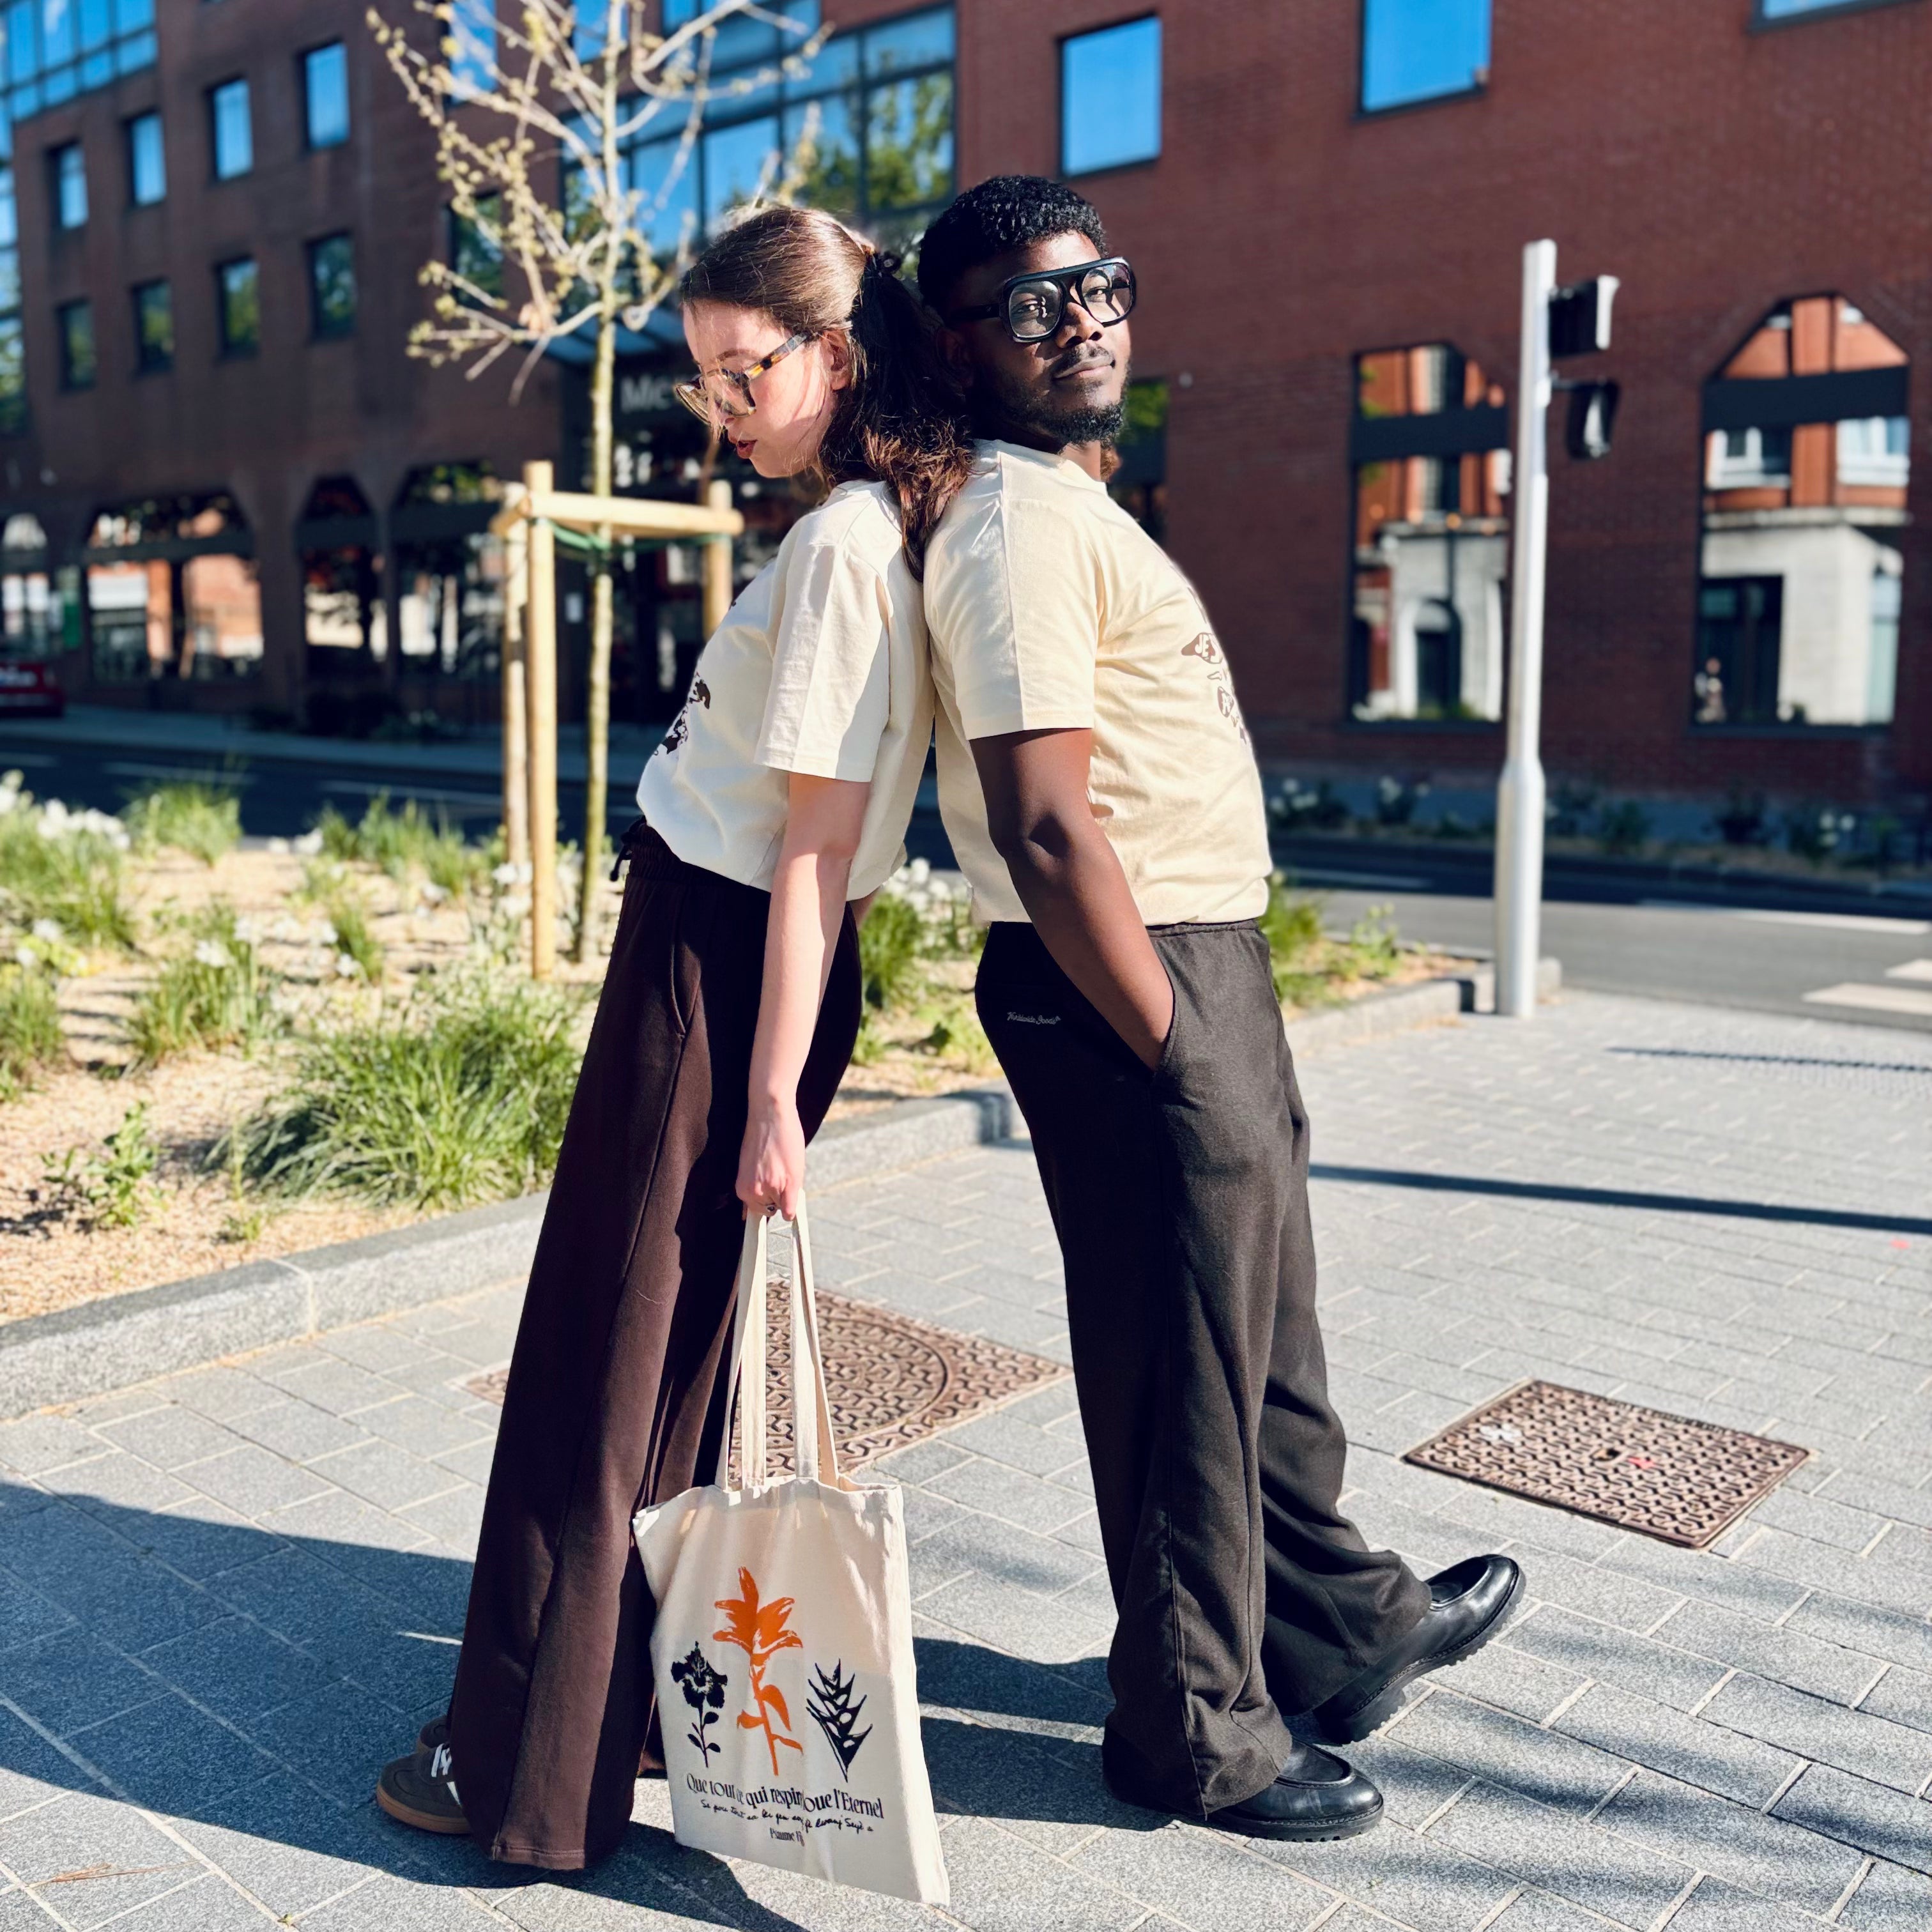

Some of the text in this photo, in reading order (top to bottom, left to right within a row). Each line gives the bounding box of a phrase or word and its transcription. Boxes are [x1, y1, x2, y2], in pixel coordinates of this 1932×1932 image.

[686, 1773, 708, 1794] Que
[710, 1781, 735, 1800] tout
[746, 1786, 769, 1809] qui
